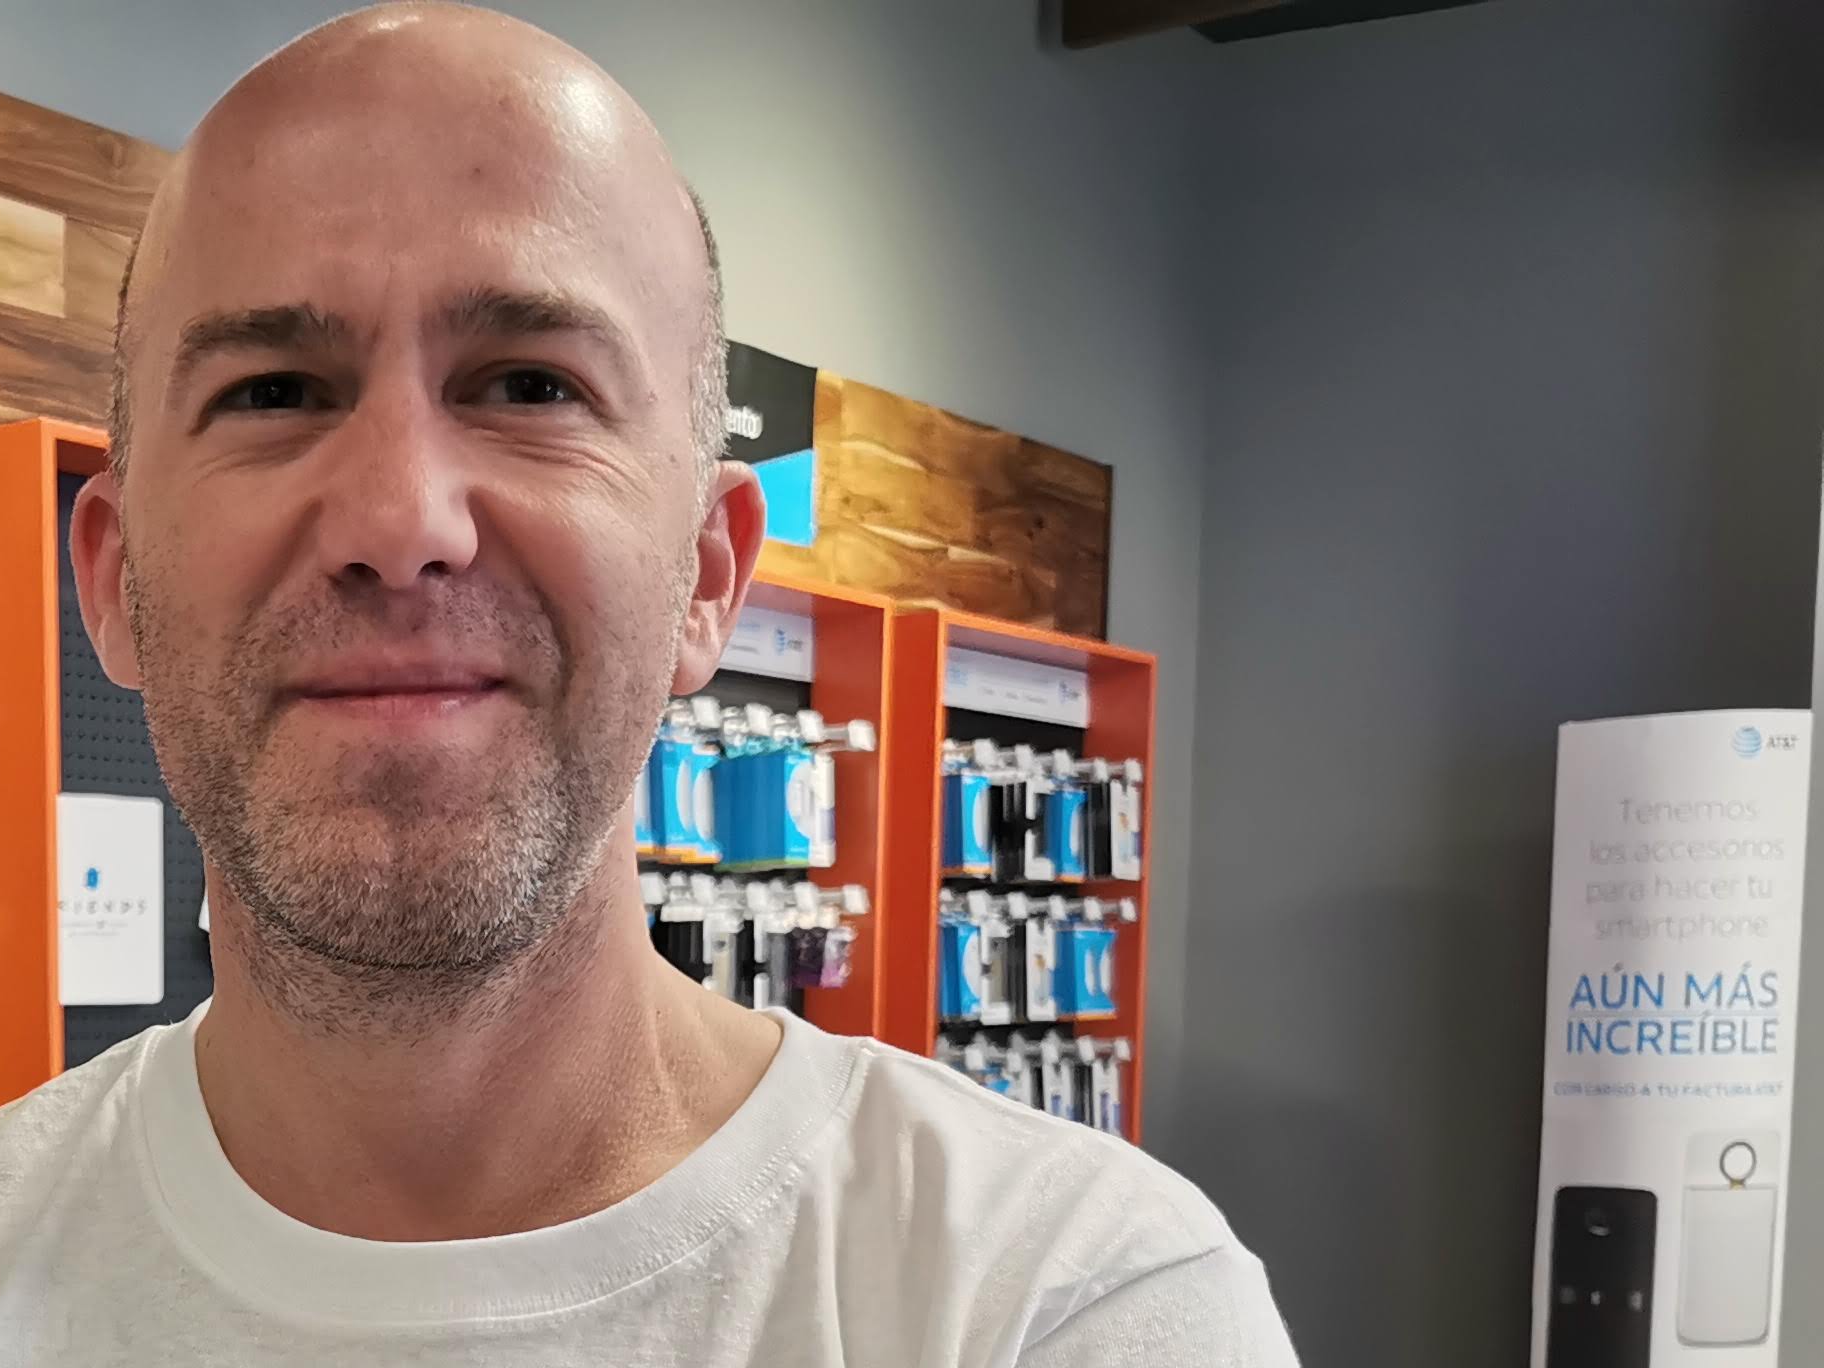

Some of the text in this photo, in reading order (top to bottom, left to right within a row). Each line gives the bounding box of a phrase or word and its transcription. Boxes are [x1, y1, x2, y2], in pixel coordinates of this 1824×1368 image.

[1766, 735, 1798, 750] AT&T
[1618, 797, 1759, 824] Tenemos
[1590, 837, 1785, 865] los accesorios
[1585, 874, 1773, 905] para hacer tu
[1595, 912, 1769, 942] smartphone
[1569, 961, 1779, 1010] AÚN MÁS
[1566, 1010, 1779, 1055] INCREÍBLE
